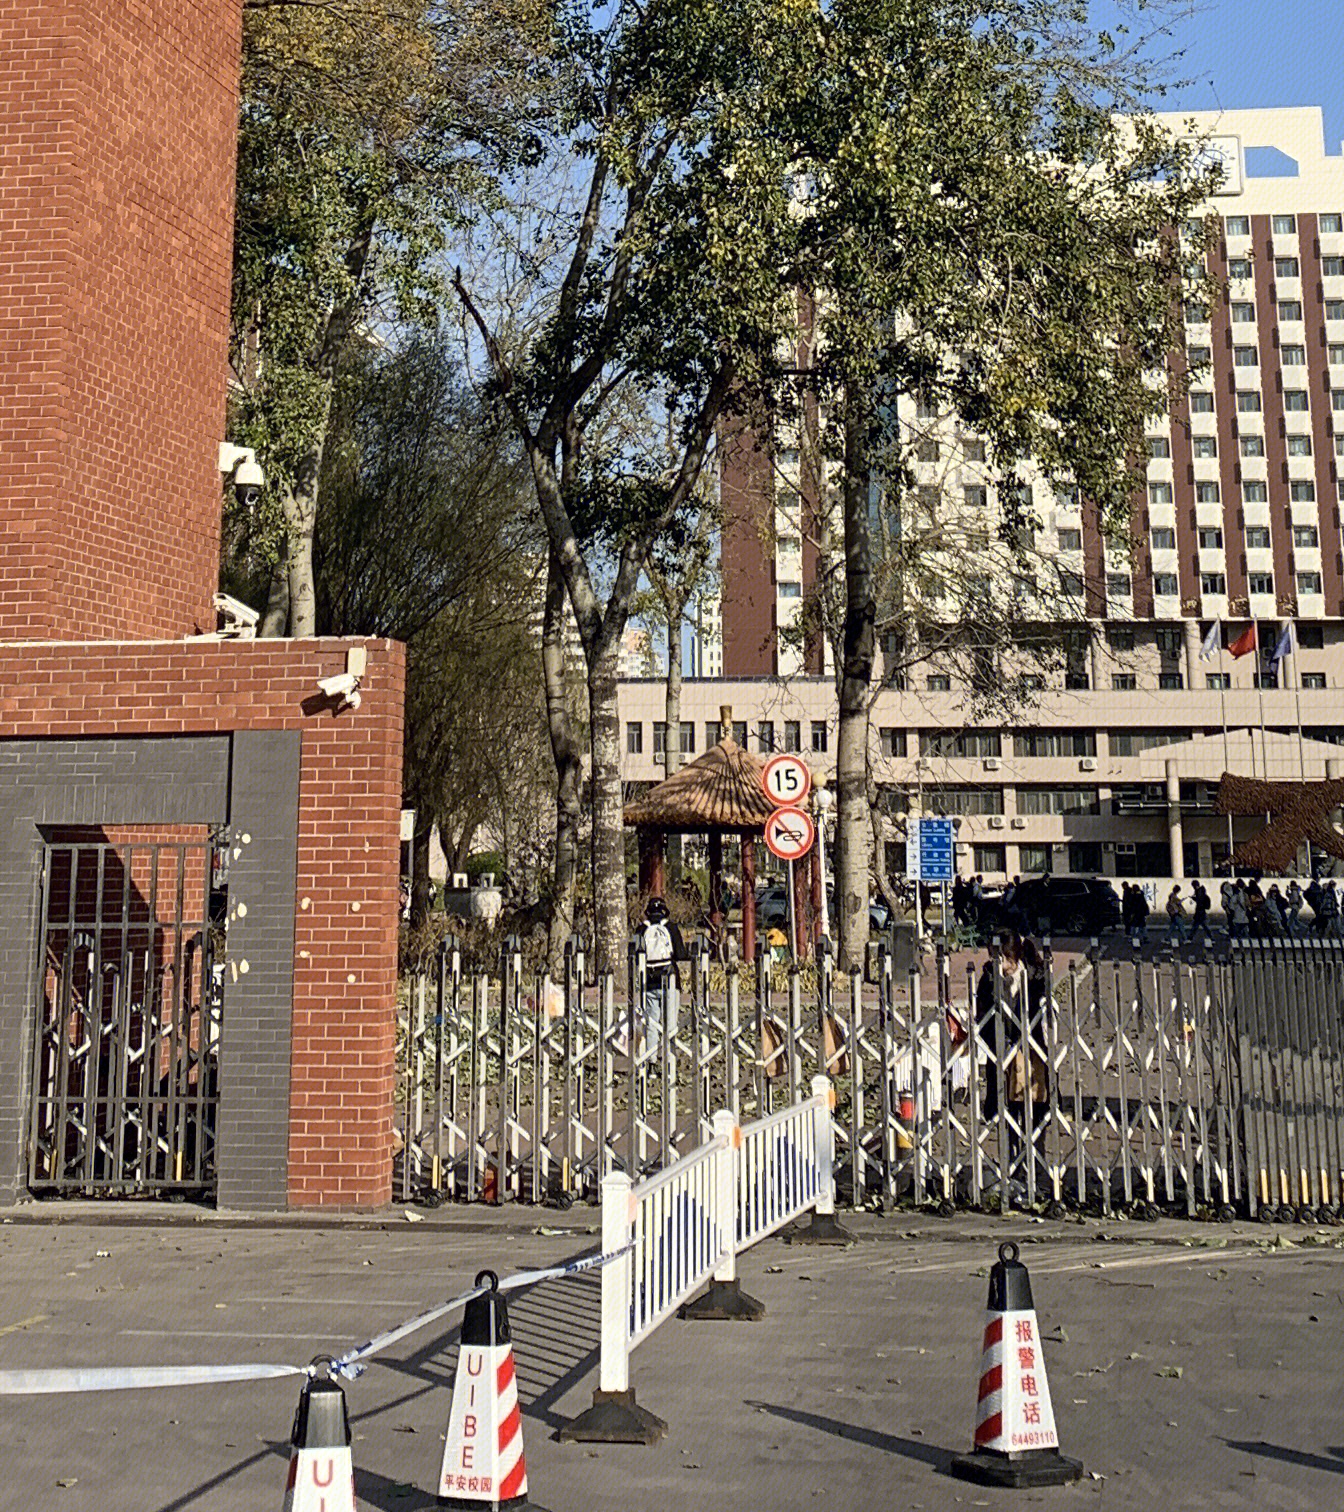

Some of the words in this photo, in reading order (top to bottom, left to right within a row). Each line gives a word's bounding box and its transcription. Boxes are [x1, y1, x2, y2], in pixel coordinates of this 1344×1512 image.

[774, 768, 798, 792] 15
[1014, 1320, 1041, 1426] 报警电话
[461, 1353, 483, 1469] UIBE
[1011, 1431, 1055, 1446] 64493110
[444, 1473, 492, 1493] 平安校园
